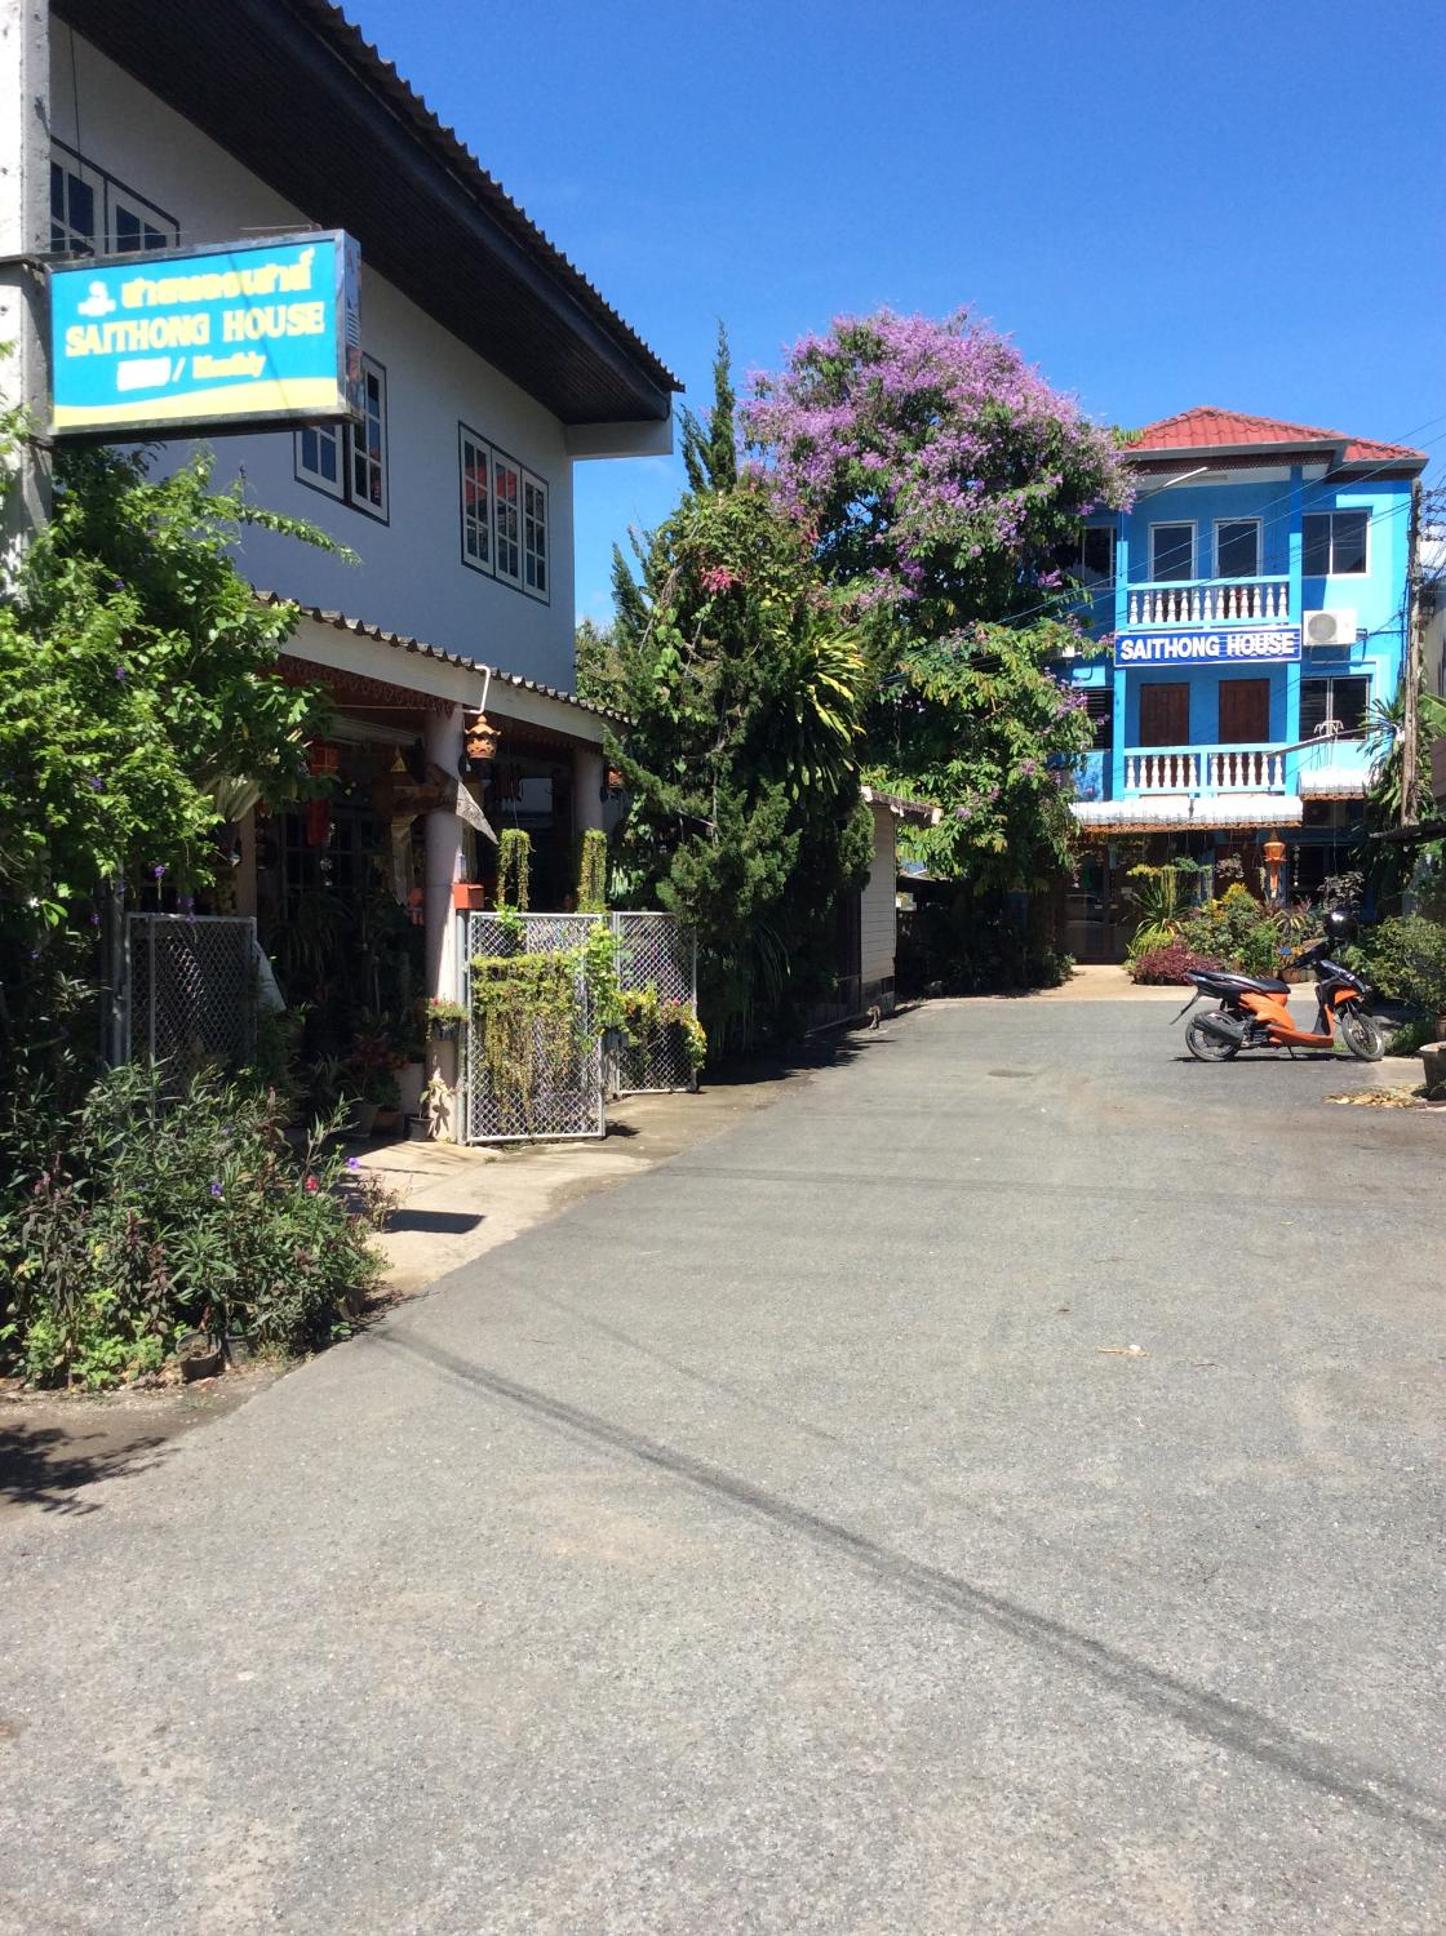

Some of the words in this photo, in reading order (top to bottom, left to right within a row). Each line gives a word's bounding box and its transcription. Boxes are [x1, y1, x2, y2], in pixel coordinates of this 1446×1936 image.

[65, 312, 210, 357] SAITHONG
[223, 301, 325, 343] HOUSE
[1120, 637, 1220, 660] SAITHONG
[1227, 631, 1295, 657] HOUSE
